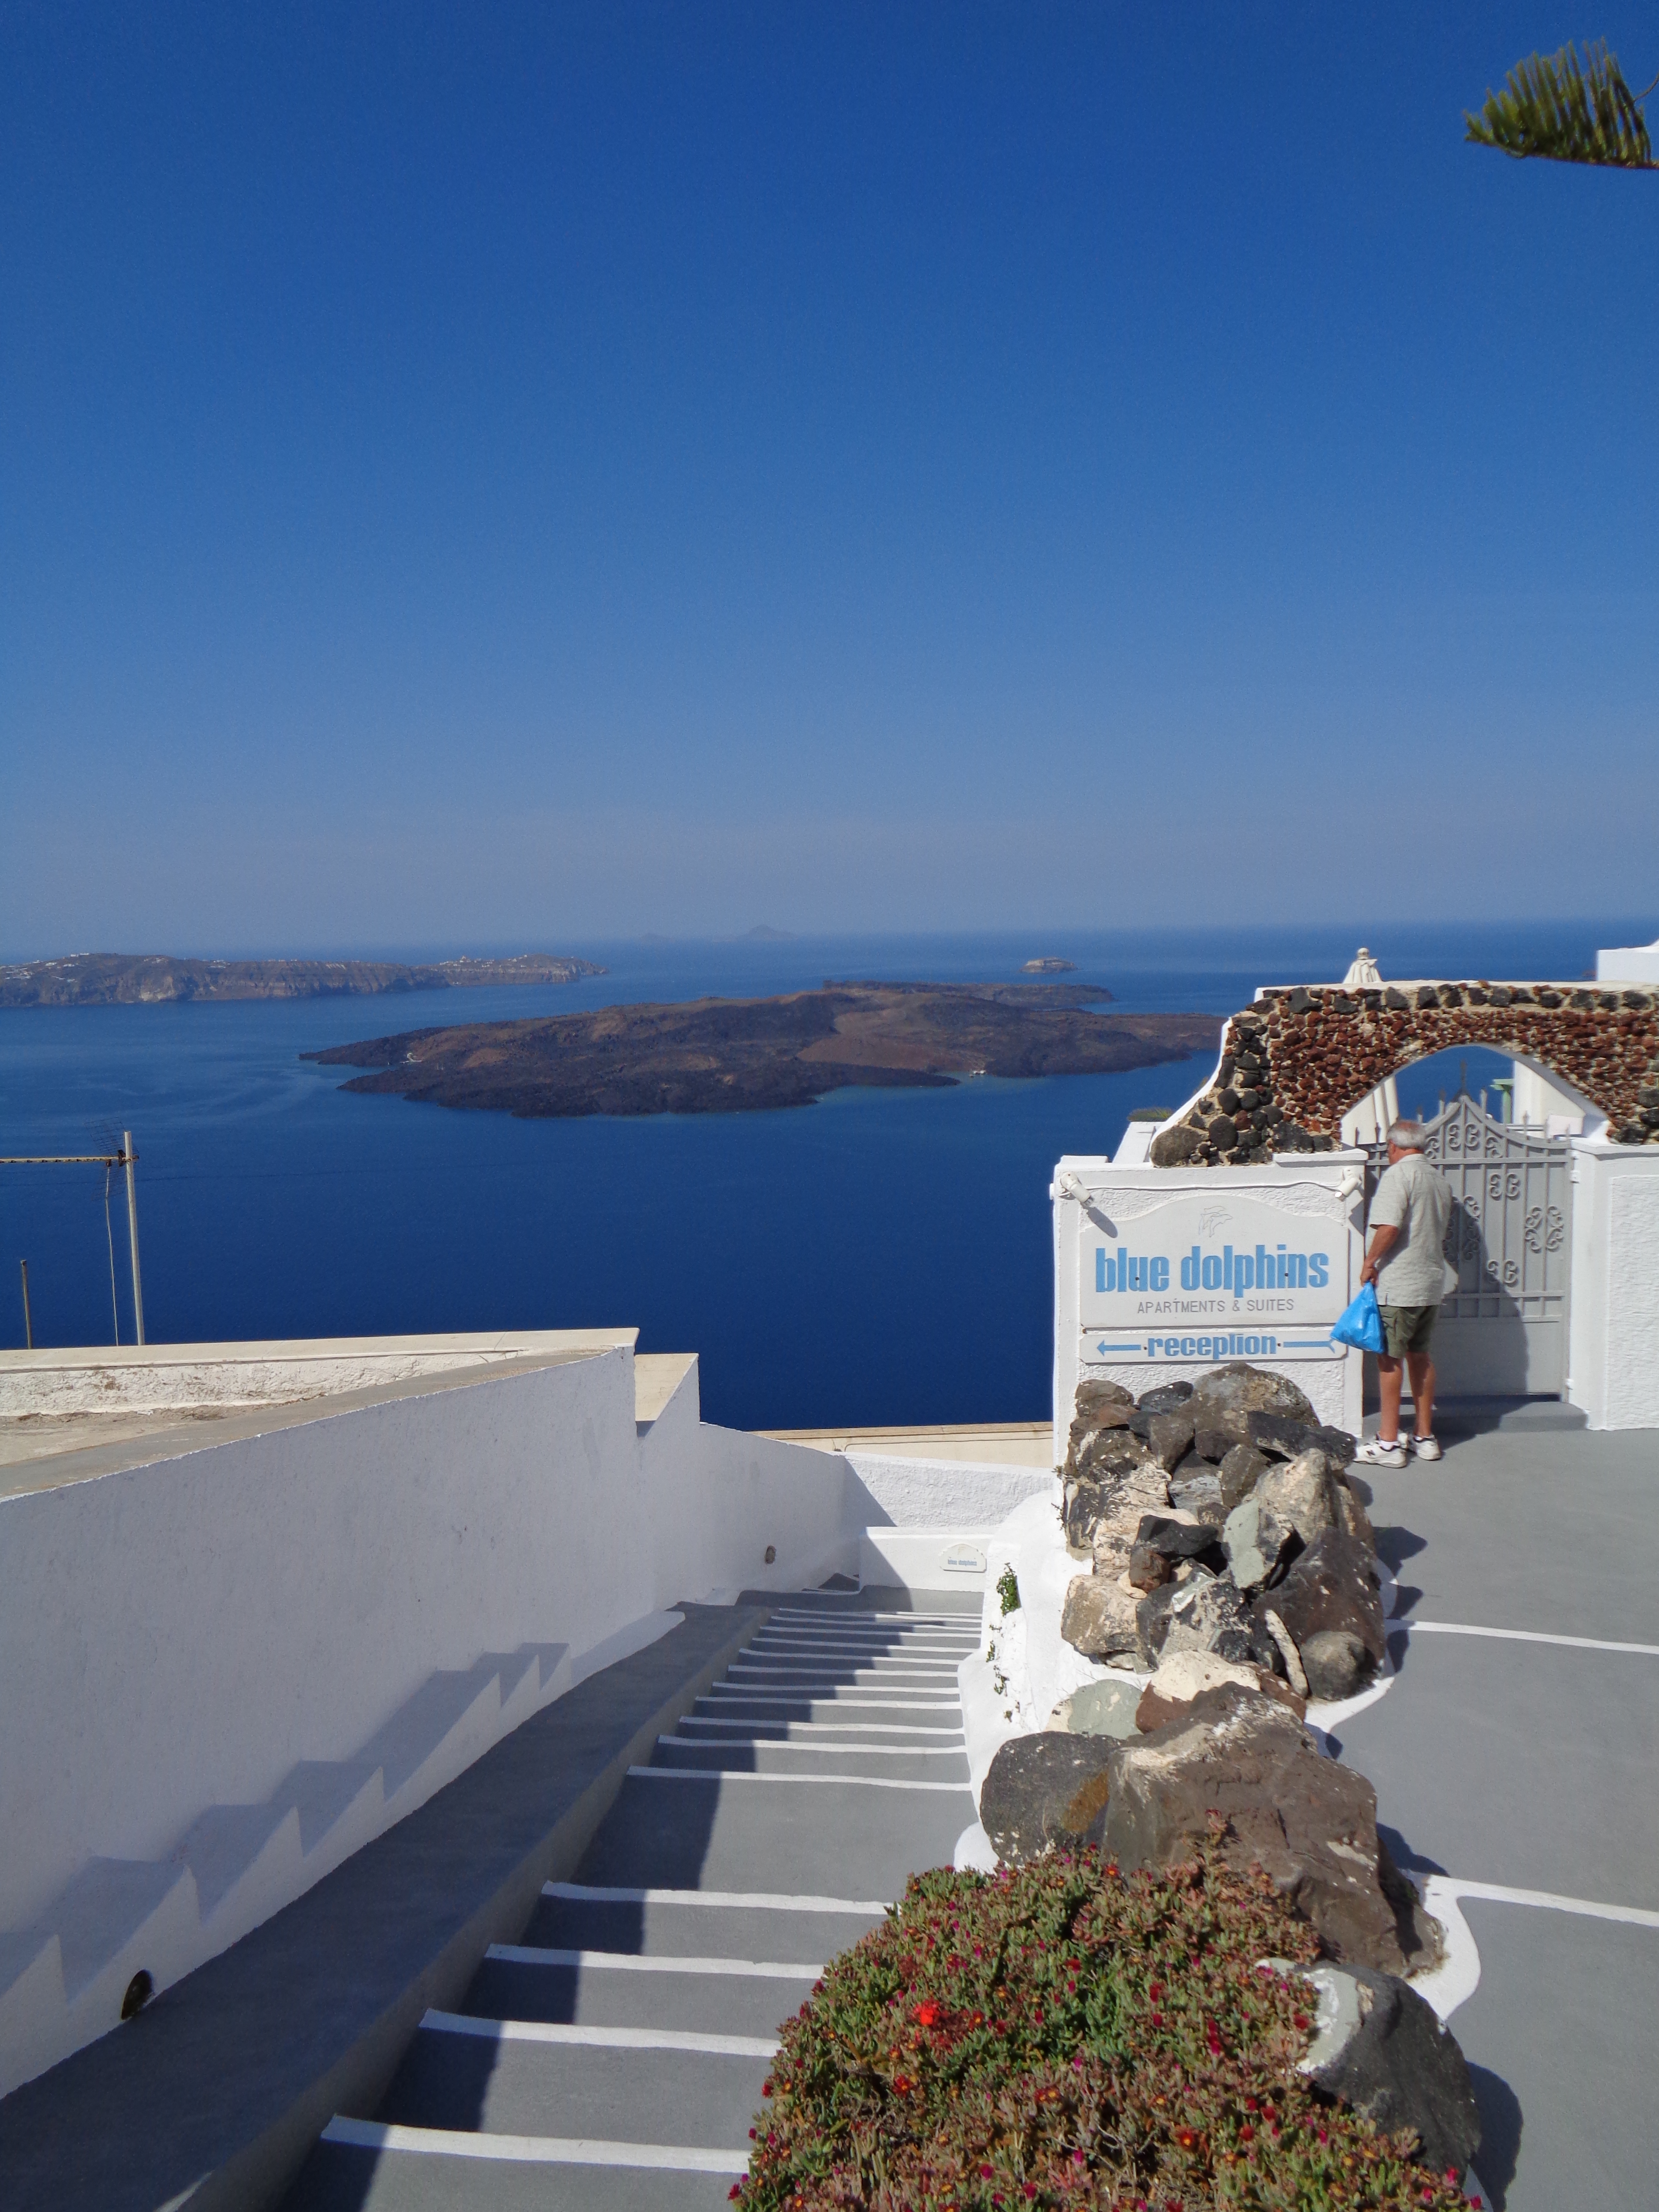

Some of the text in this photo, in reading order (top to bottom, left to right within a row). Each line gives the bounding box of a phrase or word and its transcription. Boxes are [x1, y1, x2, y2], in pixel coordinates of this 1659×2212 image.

[1095, 1244, 1329, 1298] blue dolphins
[1137, 1298, 1294, 1314] APARTMENTS & SUITES
[1148, 1334, 1277, 1360] reception
